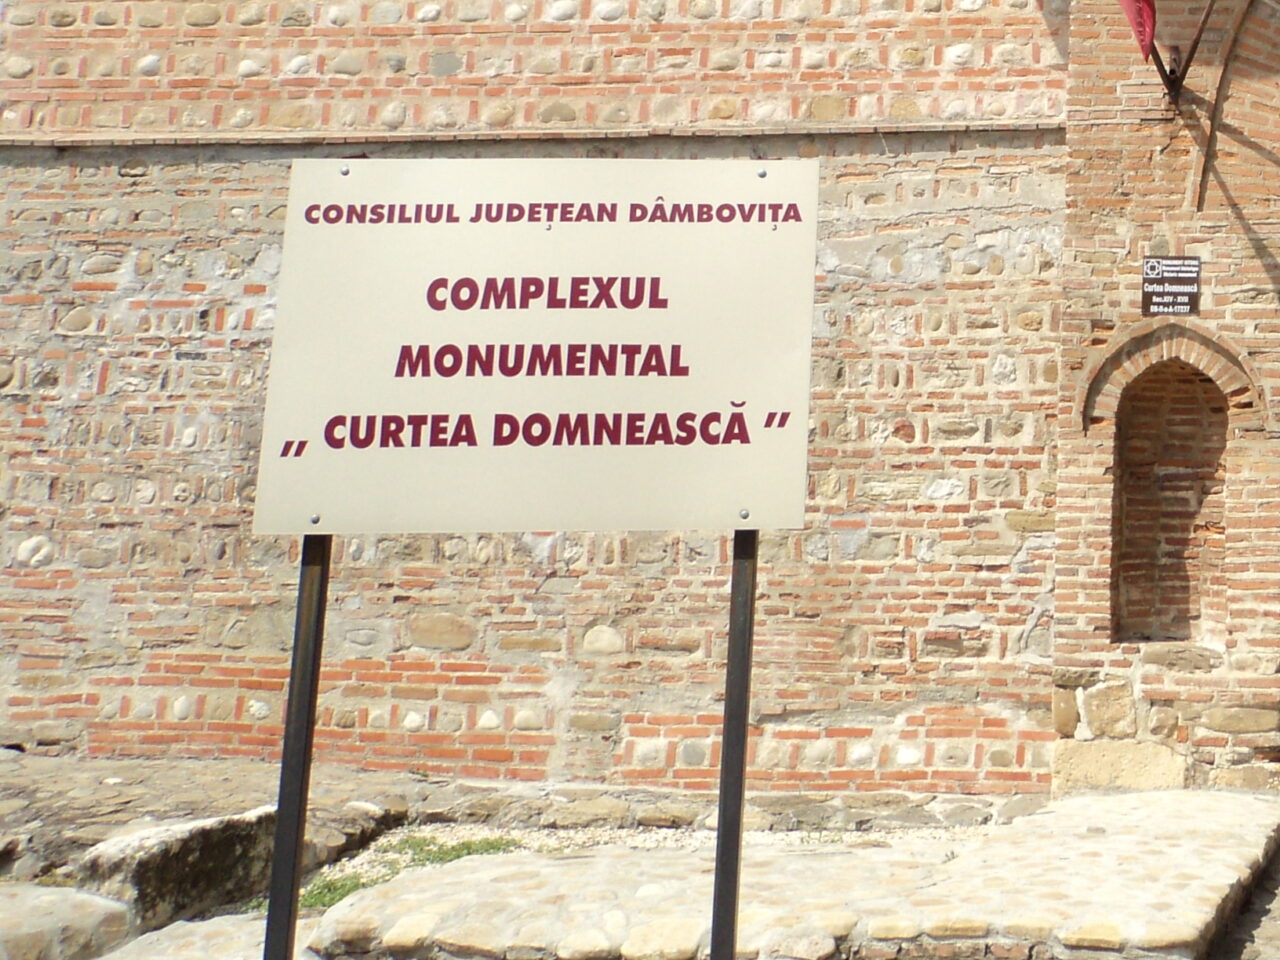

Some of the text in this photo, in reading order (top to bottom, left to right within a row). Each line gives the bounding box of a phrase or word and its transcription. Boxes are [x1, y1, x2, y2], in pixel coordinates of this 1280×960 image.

[304, 203, 460, 225] CONSILIUL
[426, 276, 669, 311] COMPLEXUL
[1144, 282, 1198, 293] Curtea Domnească
[394, 343, 690, 378] MONUMENTAL
[323, 414, 478, 450] CURTEA
[492, 401, 751, 447] DOMNEASCĂ
